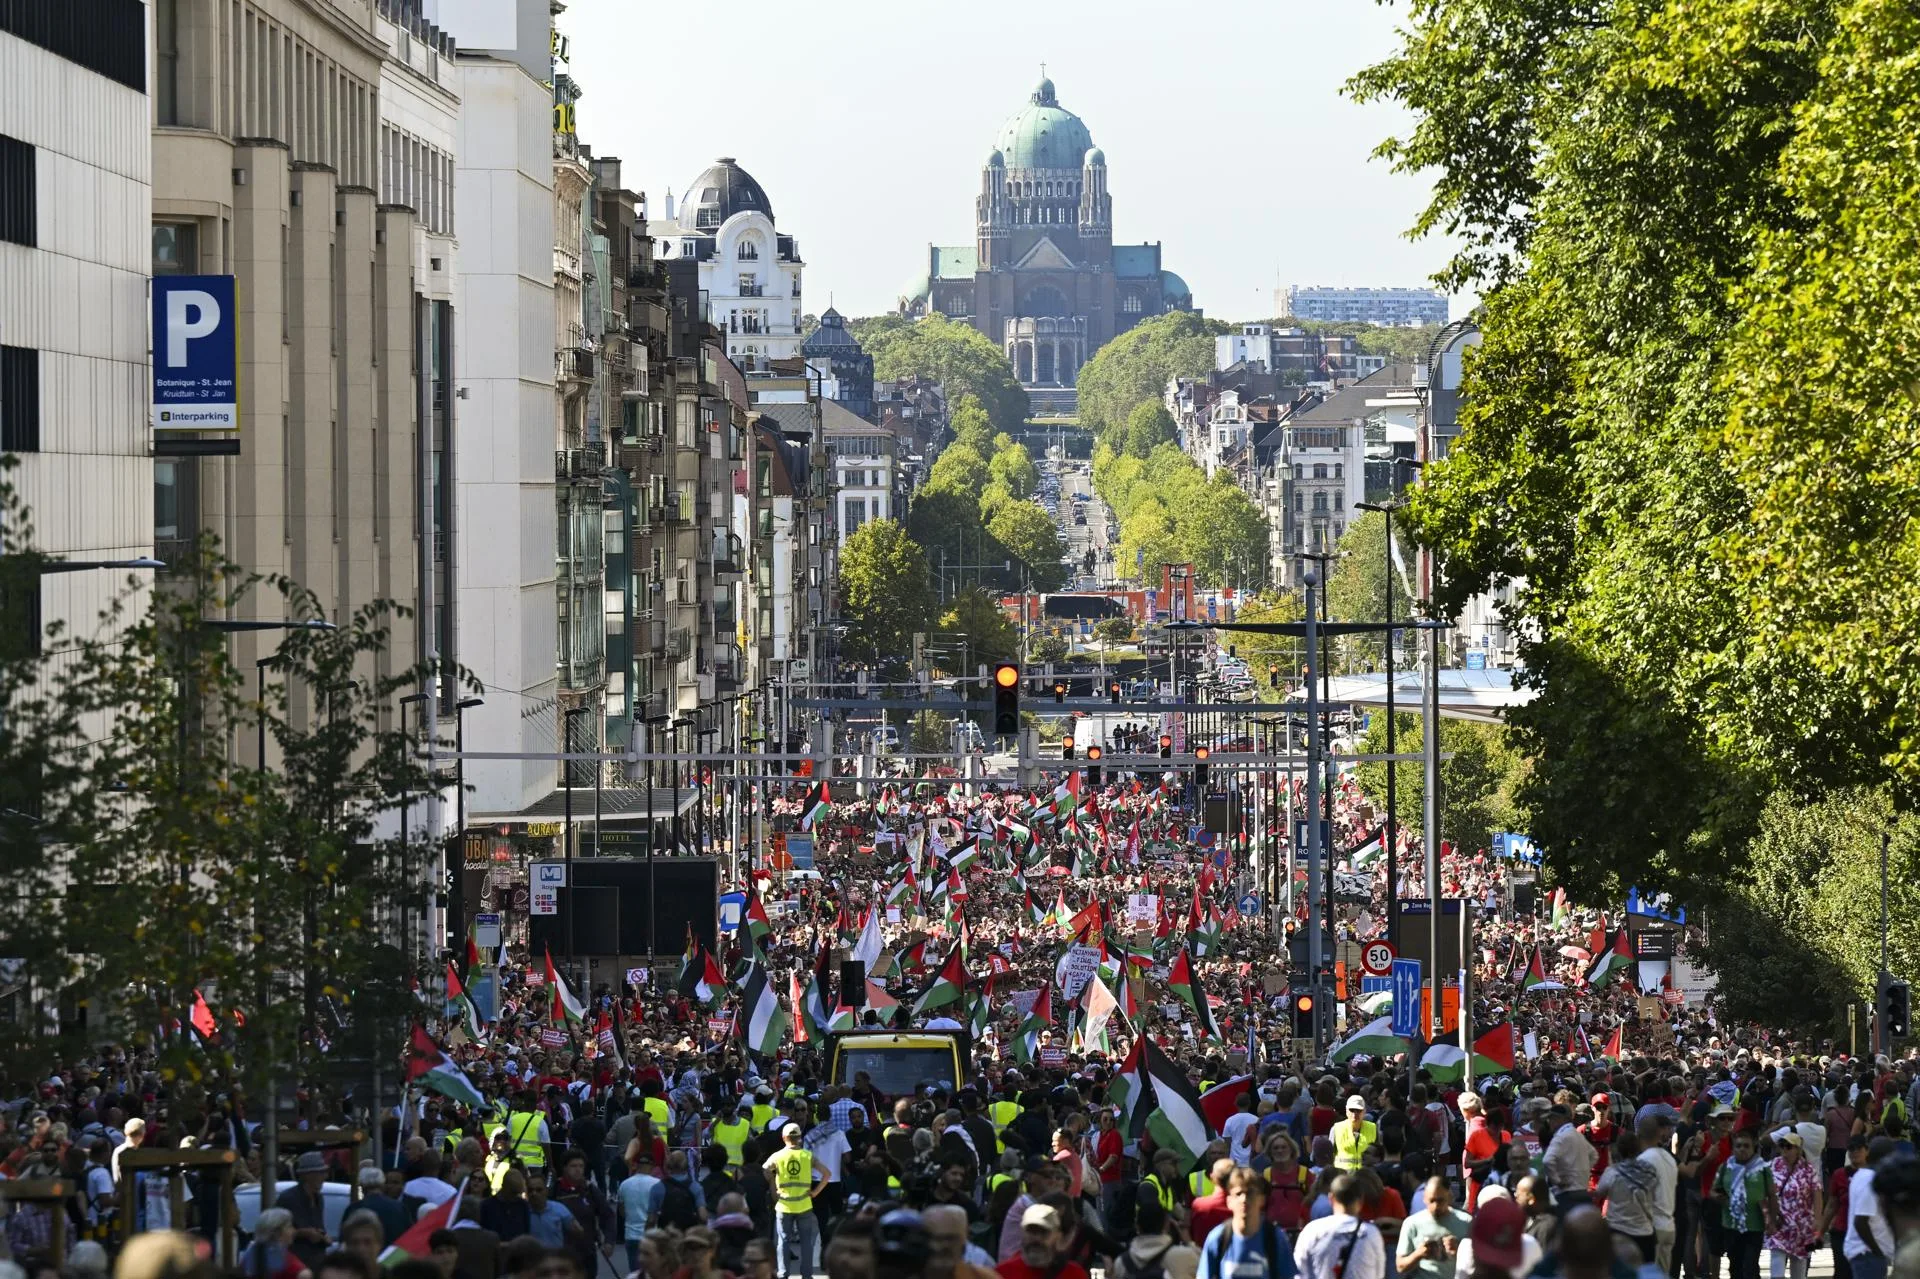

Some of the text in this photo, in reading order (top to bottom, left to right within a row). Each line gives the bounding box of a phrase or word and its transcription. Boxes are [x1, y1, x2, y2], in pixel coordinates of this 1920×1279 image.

[166, 290, 220, 368] P
[157, 379, 195, 388] Botanique
[163, 390, 194, 398] Kruidtuin
[172, 412, 229, 422] Interparking
[1494, 834, 1501, 842] P
[1402, 902, 1409, 912] P
[1370, 950, 1388, 962] 50
[1528, 1143, 1540, 1152] op
